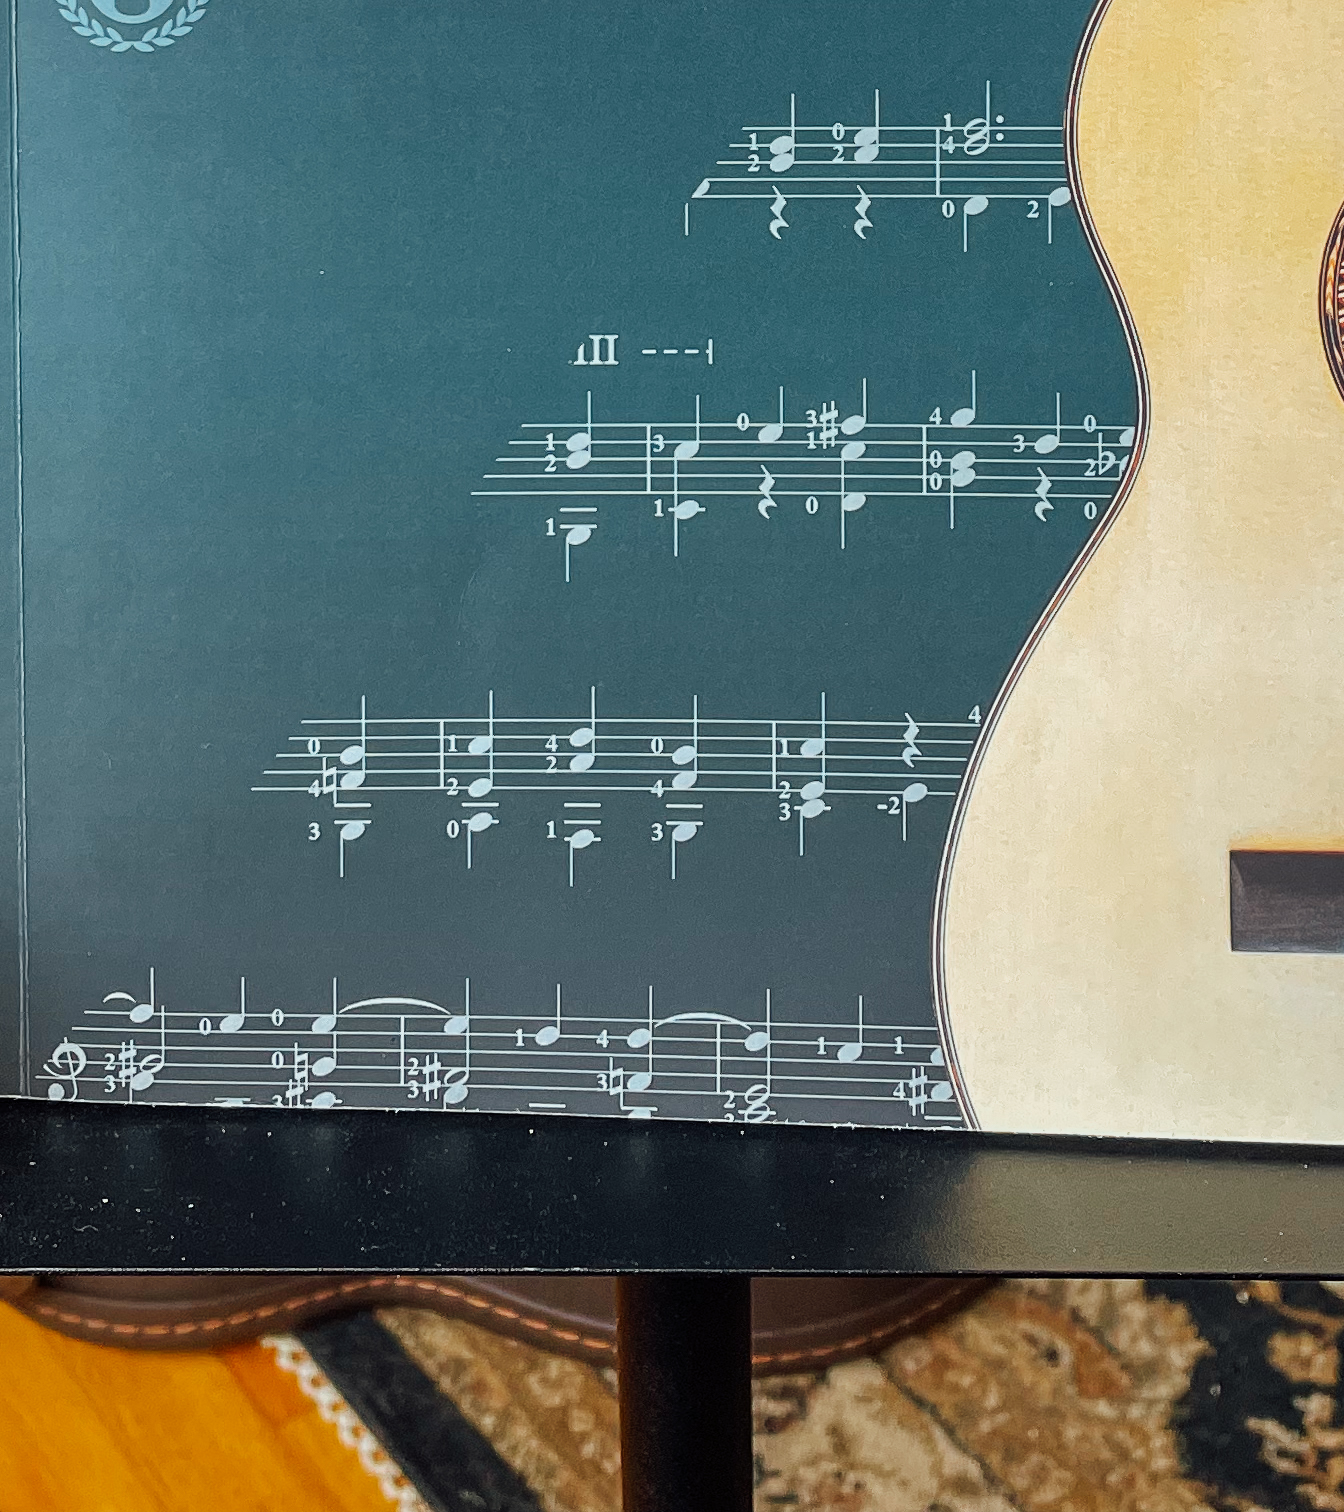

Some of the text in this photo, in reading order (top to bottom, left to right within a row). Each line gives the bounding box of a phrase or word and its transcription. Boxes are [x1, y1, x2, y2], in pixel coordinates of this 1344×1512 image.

[831, 122, 845, 141] 0
[943, 113, 953, 132] 1
[748, 132, 759, 151] 1
[747, 154, 761, 173] 2
[832, 146, 845, 163] 2
[941, 200, 955, 219] 0
[1026, 200, 1040, 219] 2
[736, 412, 749, 431] 0
[805, 409, 817, 427] 3
[929, 407, 943, 425] 4
[1083, 414, 1097, 433] 0
[545, 432, 555, 451] 1
[652, 433, 665, 452] 3
[806, 431, 817, 450] 1
[1012, 434, 1025, 453] 3
[544, 454, 557, 472] 2
[929, 449, 942, 469] 0
[1083, 458, 1096, 477] 2
[929, 472, 942, 491] 0
[654, 498, 664, 517] 1
[805, 495, 819, 515] 0
[1083, 501, 1098, 520] 0
[545, 517, 557, 536] 1
[968, 705, 982, 724] 4
[307, 737, 321, 755] 0
[545, 734, 558, 753] 4
[651, 737, 664, 756] 0
[546, 756, 557, 774] 2
[446, 778, 459, 796] 2
[778, 781, 791, 800] 2
[778, 802, 791, 821] 3
[308, 822, 320, 841] 3
[446, 820, 460, 839] 0
[546, 820, 557, 839] 1
[651, 823, 664, 842] 3
[198, 1018, 212, 1035] 0
[515, 1029, 525, 1047] 1
[595, 1029, 610, 1048] 4
[817, 1037, 827, 1055] 1
[894, 1036, 904, 1054] 1
[104, 1053, 116, 1070] 2
[271, 1051, 285, 1069] 0
[407, 1058, 419, 1075] 2
[104, 1075, 116, 1093] 3
[407, 1080, 419, 1098] 3
[596, 1074, 608, 1091] 3
